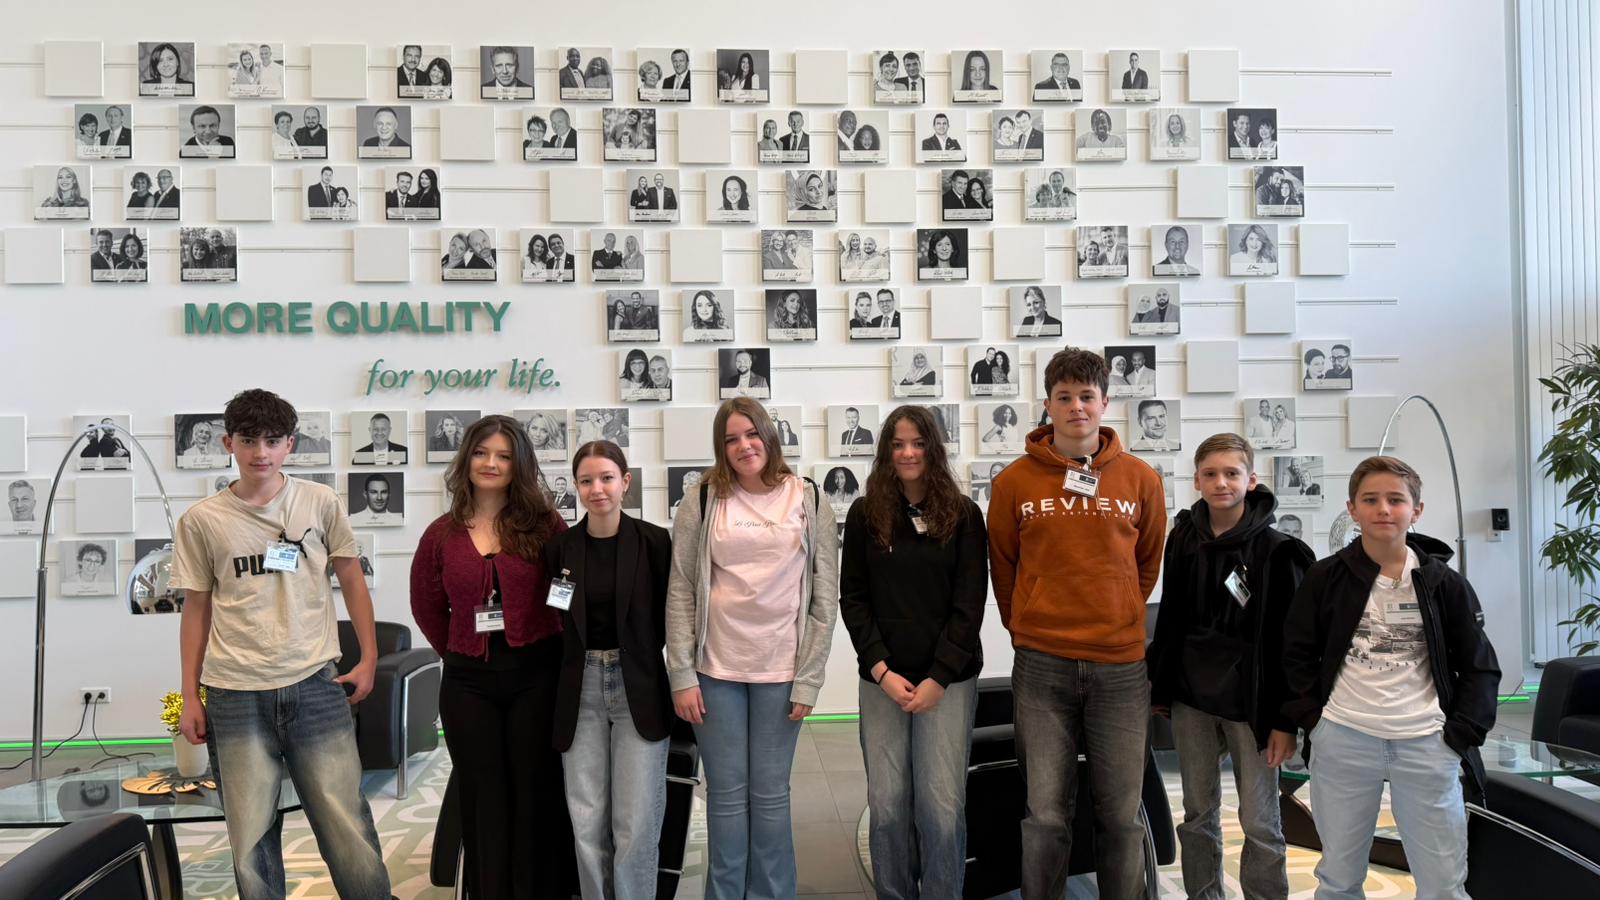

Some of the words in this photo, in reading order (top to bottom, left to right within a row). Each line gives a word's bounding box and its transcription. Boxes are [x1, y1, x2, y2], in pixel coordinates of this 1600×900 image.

[184, 302, 313, 334] MORE
[326, 301, 512, 334] QUALITY
[366, 358, 414, 395] for
[424, 369, 497, 395] your
[508, 358, 560, 394] life.
[1021, 496, 1136, 516] REVIEW
[233, 554, 283, 578] PU
